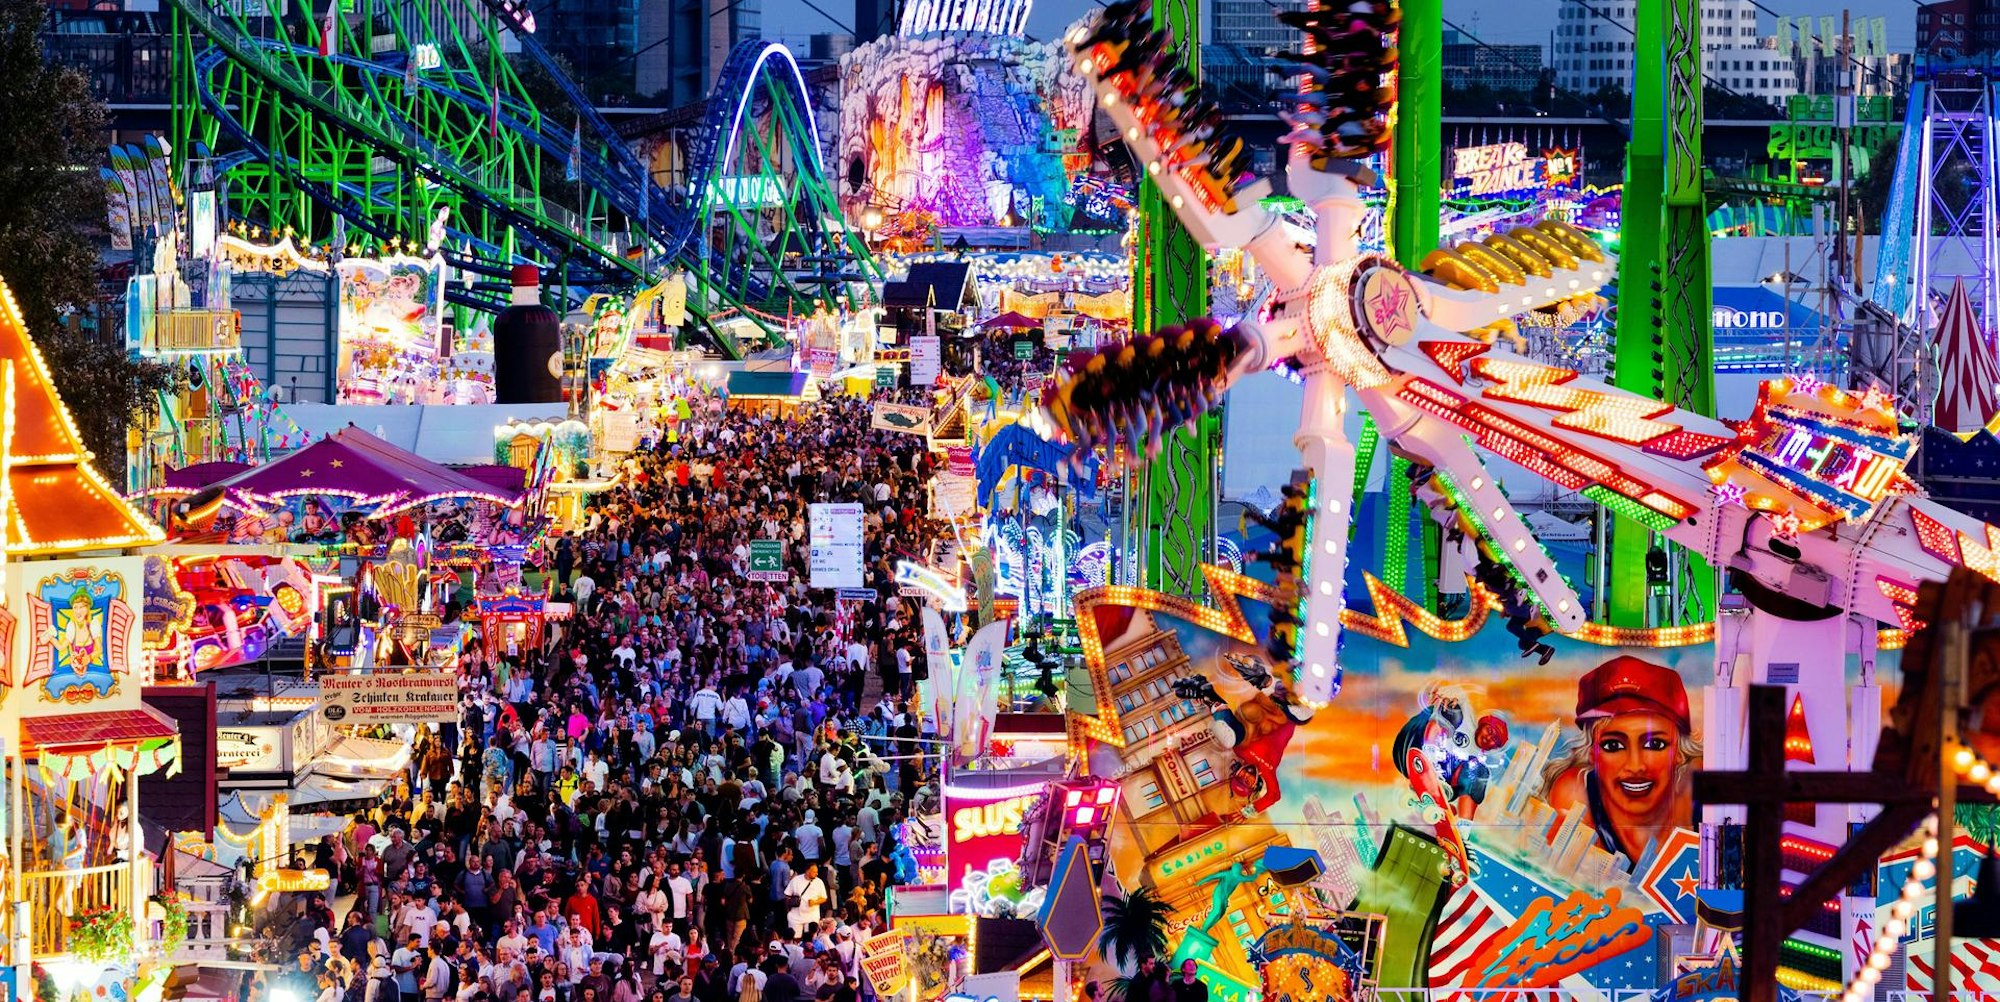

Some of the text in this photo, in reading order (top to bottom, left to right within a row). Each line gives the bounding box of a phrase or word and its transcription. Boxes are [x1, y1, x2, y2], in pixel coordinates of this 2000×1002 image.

[1470, 160, 1536, 195] DANCE
[376, 705, 454, 713] HOLZKOHLENGRILL
[1164, 752, 1188, 795] HOTEL
[1161, 841, 1224, 874] CASINO
[1676, 956, 1742, 999] SKA
